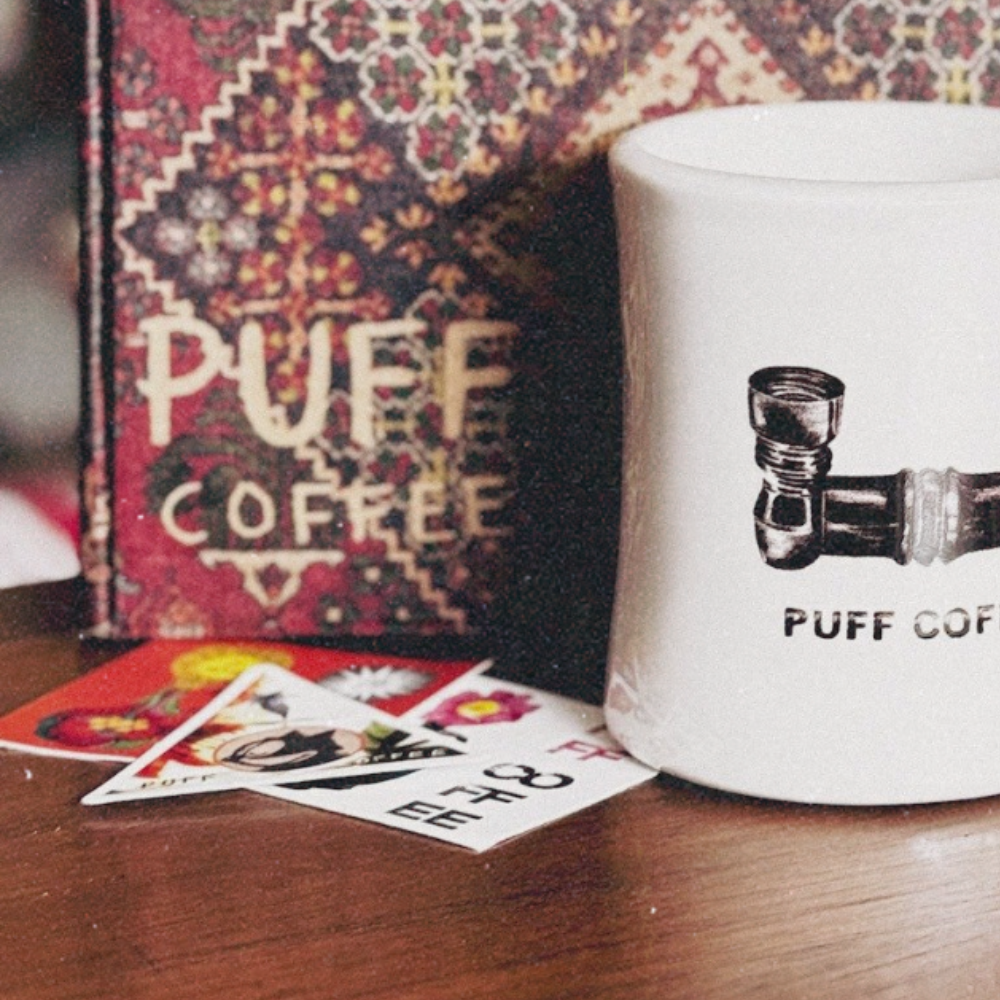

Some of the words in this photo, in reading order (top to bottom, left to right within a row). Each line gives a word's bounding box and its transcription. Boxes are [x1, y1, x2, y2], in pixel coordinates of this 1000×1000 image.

[136, 314, 520, 447] PUFF
[160, 474, 514, 547] COFFEE
[784, 606, 896, 641] PUFF
